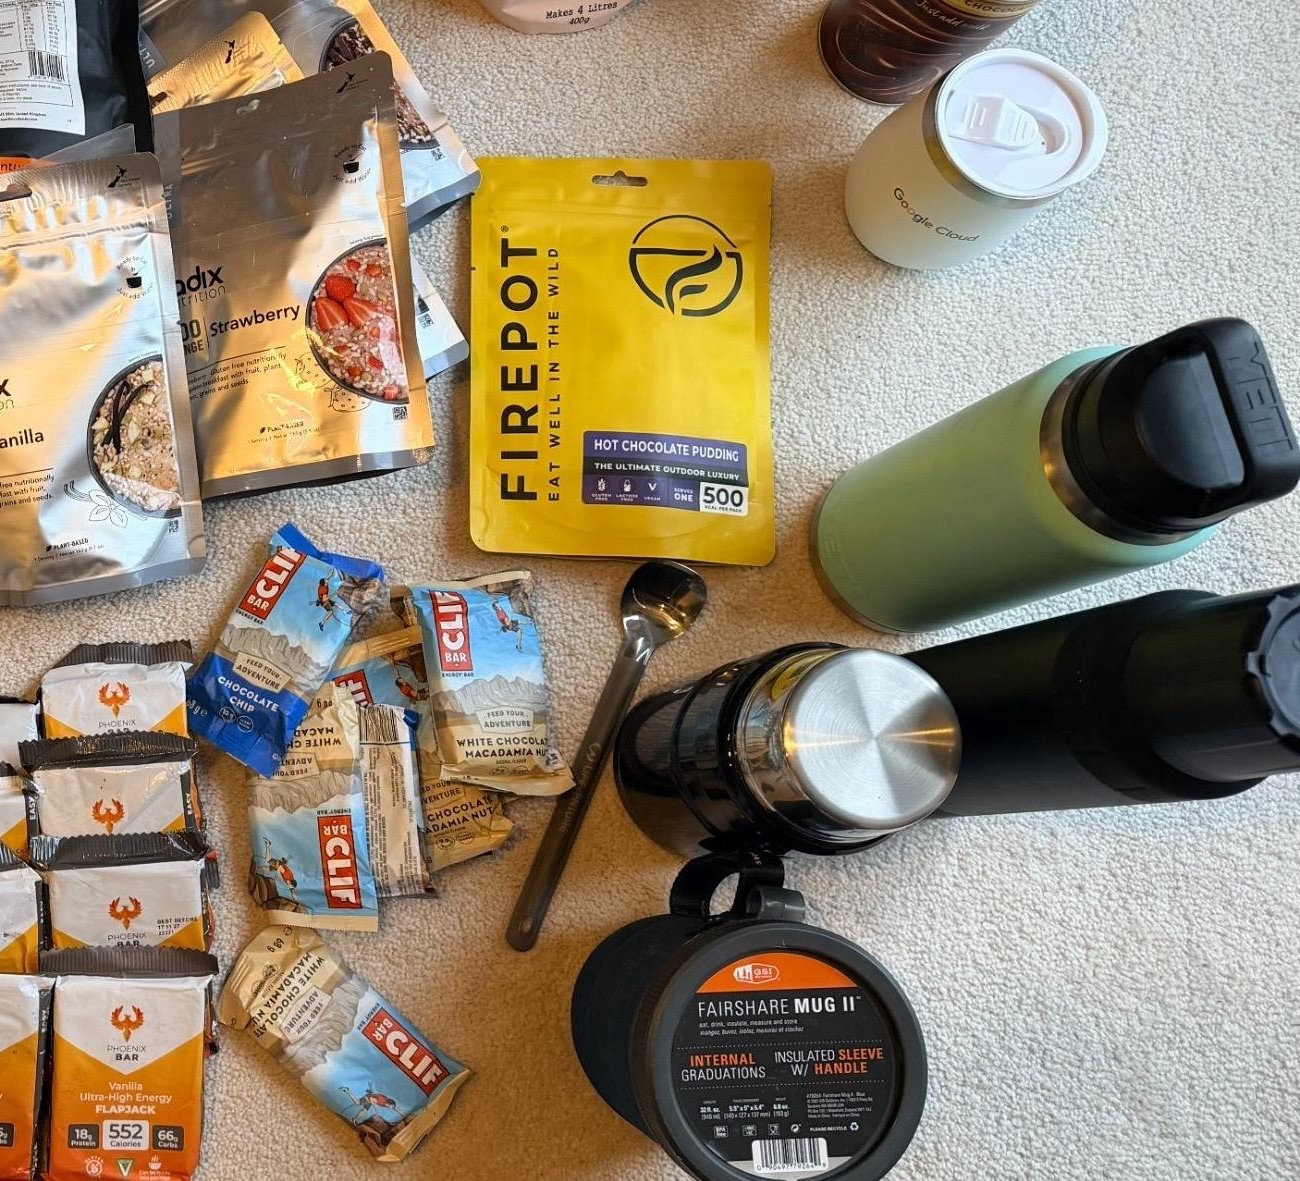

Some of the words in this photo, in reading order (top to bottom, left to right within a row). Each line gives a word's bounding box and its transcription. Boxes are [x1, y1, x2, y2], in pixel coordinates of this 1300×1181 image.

[546, 8, 574, 19] Makes
[577, 5, 584, 14] 4
[588, 1, 618, 12] Litres
[569, 17, 591, 25] 400g
[893, 187, 934, 229] Google
[935, 226, 980, 242] Cloud
[548, 248, 560, 297] WILD
[210, 302, 301, 338] Strawberry
[548, 310, 560, 349] THE
[500, 237, 539, 501] FIREPOT
[548, 362, 561, 382] IN
[548, 394, 561, 449] WELL
[594, 438, 619, 452] HOT
[621, 440, 690, 457] CHOCOLATE
[692, 445, 740, 463] PUDDING
[594, 462, 613, 471] THE
[615, 463, 661, 473] ULTIMATE
[663, 466, 706, 478] OUTDOOR
[707, 471, 741, 482] LUXURY
[0, 480, 14, 491] free
[548, 461, 561, 502] EAT
[14, 488, 30, 499] with
[674, 494, 694, 503] ONE
[702, 487, 744, 507] 500
[247, 594, 270, 612] BAR
[444, 651, 467, 663] BAR
[236, 664, 280, 691] ADVENTURE
[217, 675, 280, 713] CHOCOLATE
[229, 696, 256, 713] CHIP
[487, 710, 506, 719] FEED
[506, 710, 525, 718] YOUR
[98, 718, 137, 729] PHOENIX
[483, 719, 531, 729] ADVENTURE
[457, 738, 493, 748] WHITE
[465, 748, 534, 759] MACADAMIA
[427, 794, 494, 824] CHOCOLATE
[323, 825, 349, 836] BAR
[325, 836, 358, 904] CLIF
[106, 932, 147, 943] PHOENIX
[753, 968, 773, 976] GSI
[698, 998, 789, 1018] FAIRSHARE
[794, 996, 836, 1015] MUG
[842, 995, 855, 1012] II
[106, 1044, 147, 1053] PHOENIX
[774, 1049, 835, 1064] INSULATED
[838, 1047, 885, 1061] SLEEVE
[115, 1052, 139, 1062] BAR
[384, 1030, 444, 1087] CLIF
[690, 1052, 756, 1068] INTERNAL
[681, 1066, 766, 1082] GRADUATIONS
[791, 1062, 808, 1077] W/
[814, 1061, 868, 1075] HANDLE
[108, 1081, 144, 1092] Vanilla
[79, 1093, 134, 1102] Ultra-High
[135, 1093, 173, 1104] Energy
[95, 1104, 156, 1115] FLAPJACK
[108, 1123, 144, 1140] 552
[71, 1139, 97, 1148] Protein
[110, 1139, 142, 1148] Calories
[157, 1140, 179, 1150] Carbs
